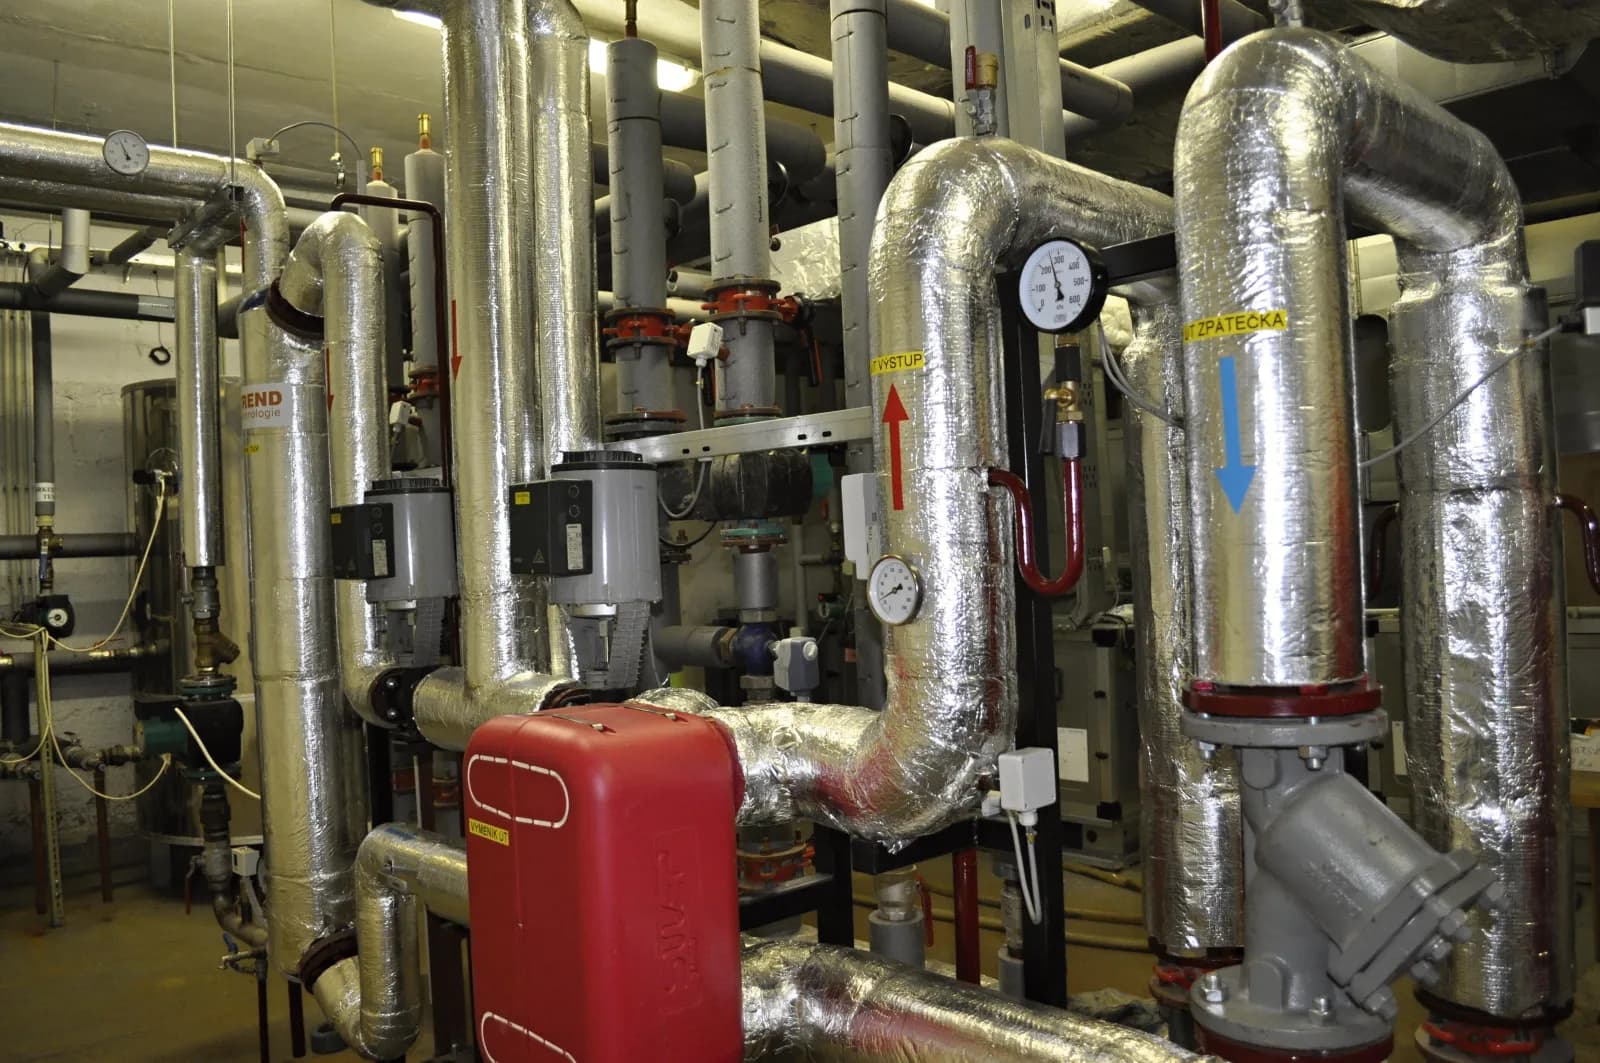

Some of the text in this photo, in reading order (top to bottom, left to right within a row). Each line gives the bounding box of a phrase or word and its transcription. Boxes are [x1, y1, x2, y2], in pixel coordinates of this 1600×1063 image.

[1041, 266, 1051, 275] 200
[1073, 277, 1084, 287] 500
[1036, 284, 1046, 293] 100
[1069, 295, 1081, 304] 600
